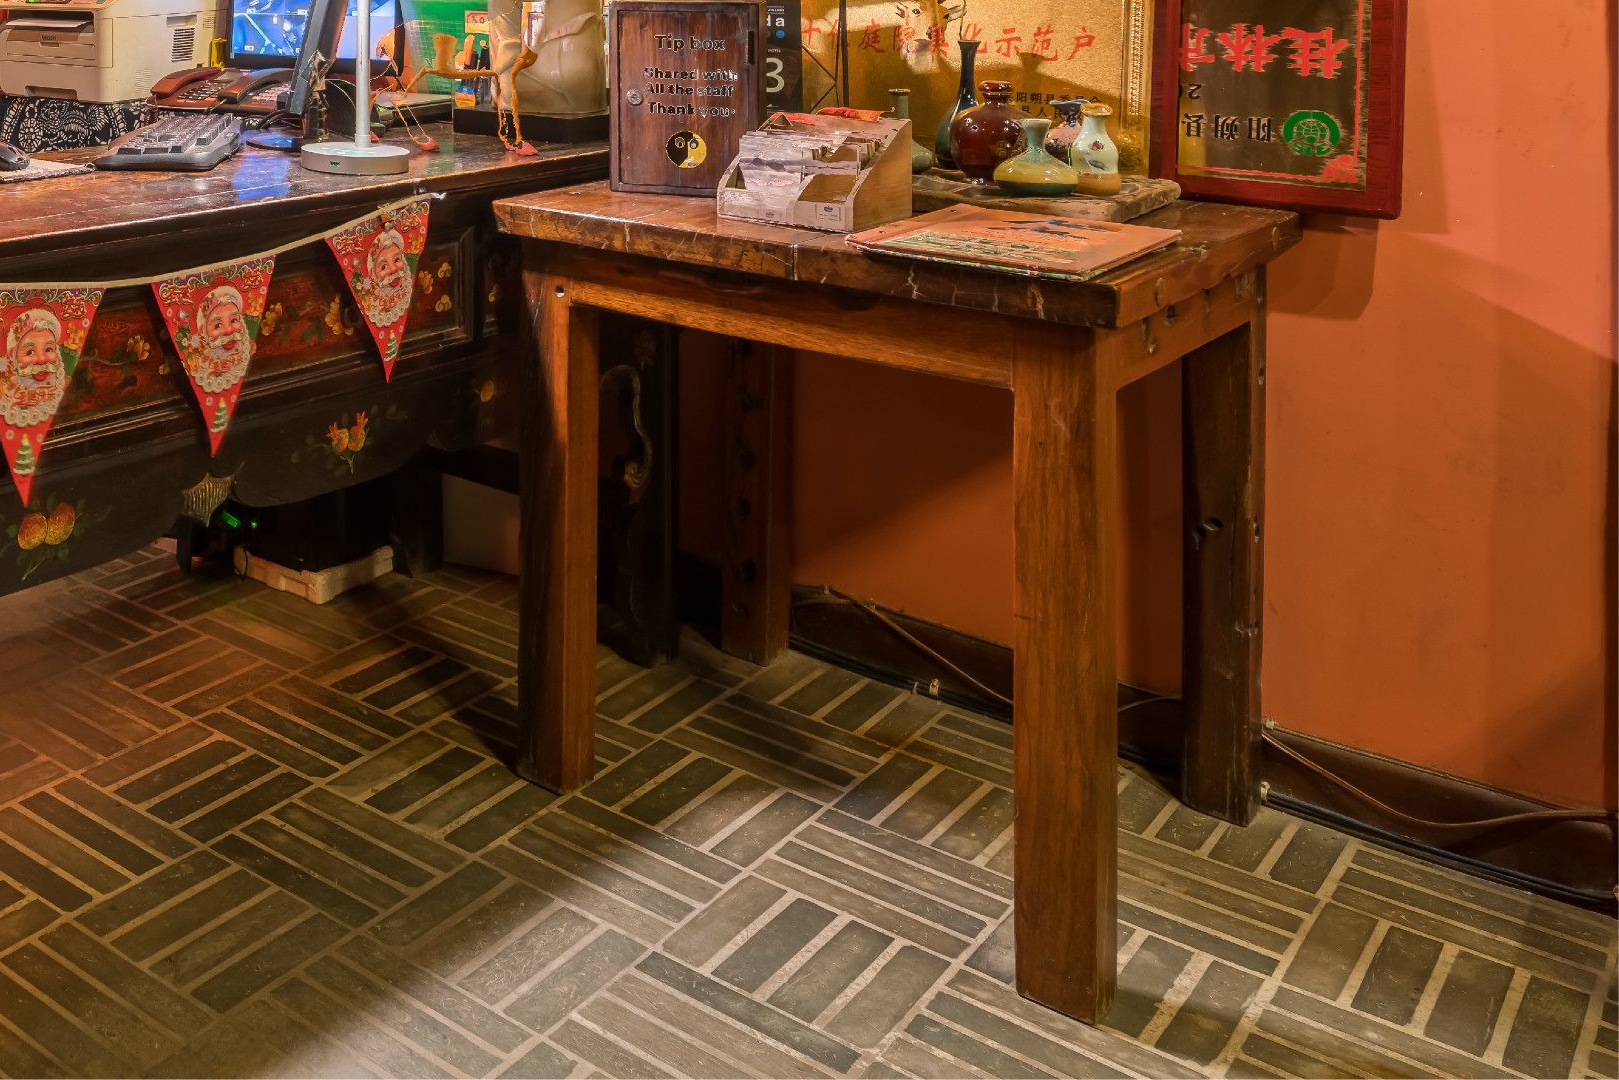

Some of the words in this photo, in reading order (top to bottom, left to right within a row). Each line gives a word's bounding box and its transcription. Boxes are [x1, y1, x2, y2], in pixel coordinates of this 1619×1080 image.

[654, 34, 684, 51] Tip
[690, 36, 726, 51] box
[643, 68, 700, 81] Shared
[702, 69, 739, 81] with
[645, 82, 665, 95] All
[668, 83, 693, 95] the
[697, 85, 734, 97] staff
[648, 101, 695, 116] Thank
[1181, 112, 1272, 143] 阳朔县
